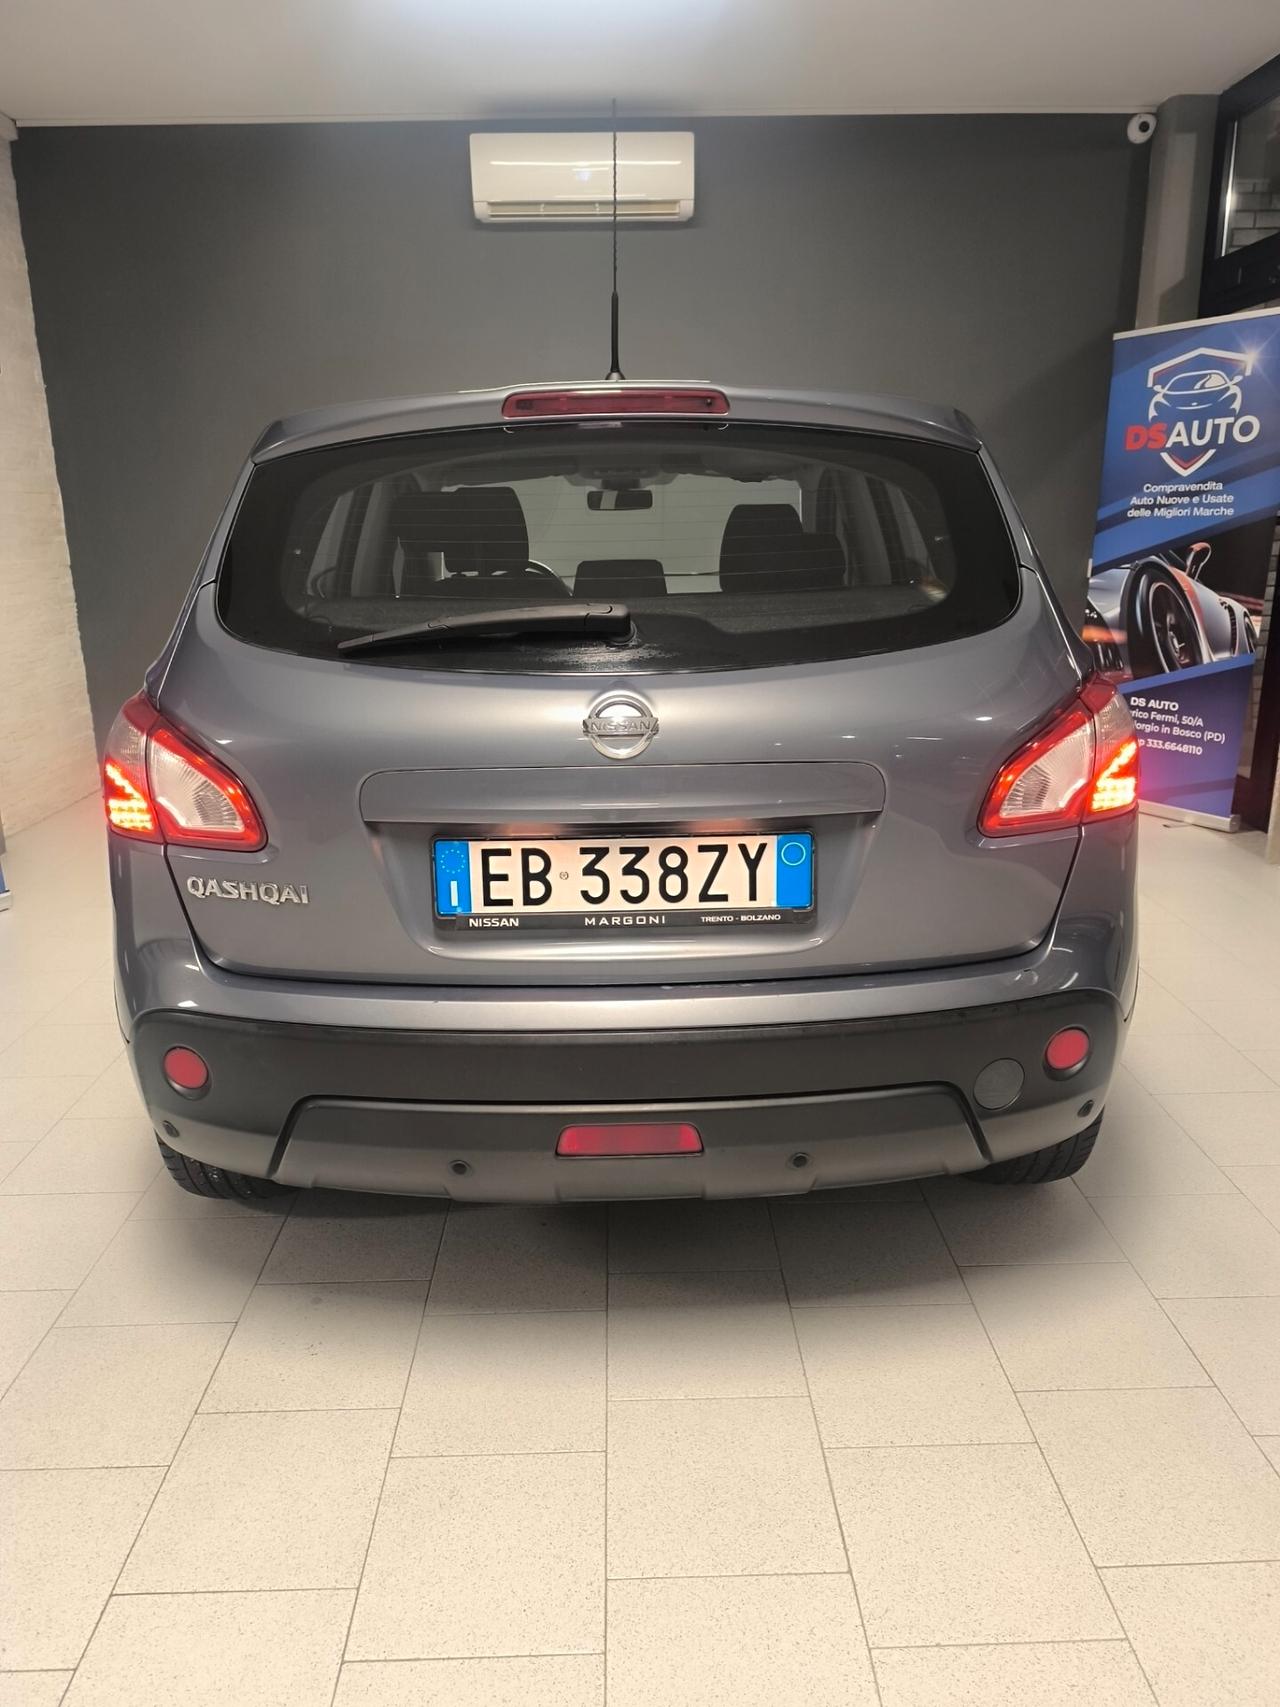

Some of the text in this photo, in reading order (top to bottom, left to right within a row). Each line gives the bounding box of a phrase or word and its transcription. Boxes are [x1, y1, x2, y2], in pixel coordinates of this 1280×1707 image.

[1124, 415, 1261, 451] DSAUTO
[1143, 481, 1223, 494] Compravendita
[1129, 494, 1235, 506] Auto Nuove e Usate
[1127, 506, 1235, 519] delle Migliori Marche
[1130, 696, 1180, 712] DS AUTO
[590, 720, 651, 731] NISSAN
[1150, 711, 1180, 725] Fermi,
[1181, 715, 1204, 728] 50/A
[1161, 724, 1171, 734] in
[1172, 726, 1202, 739] Bosco
[1203, 730, 1226, 745] (PD)
[1146, 738, 1203, 756] 333.6648110
[481, 843, 768, 907] EB 338ZY
[186, 876, 310, 906] QASHQAI
[469, 917, 520, 928] NISSAN
[584, 916, 666, 926] MARGONI
[701, 915, 735, 923] TRENTO
[740, 914, 781, 922] BOLZANO
